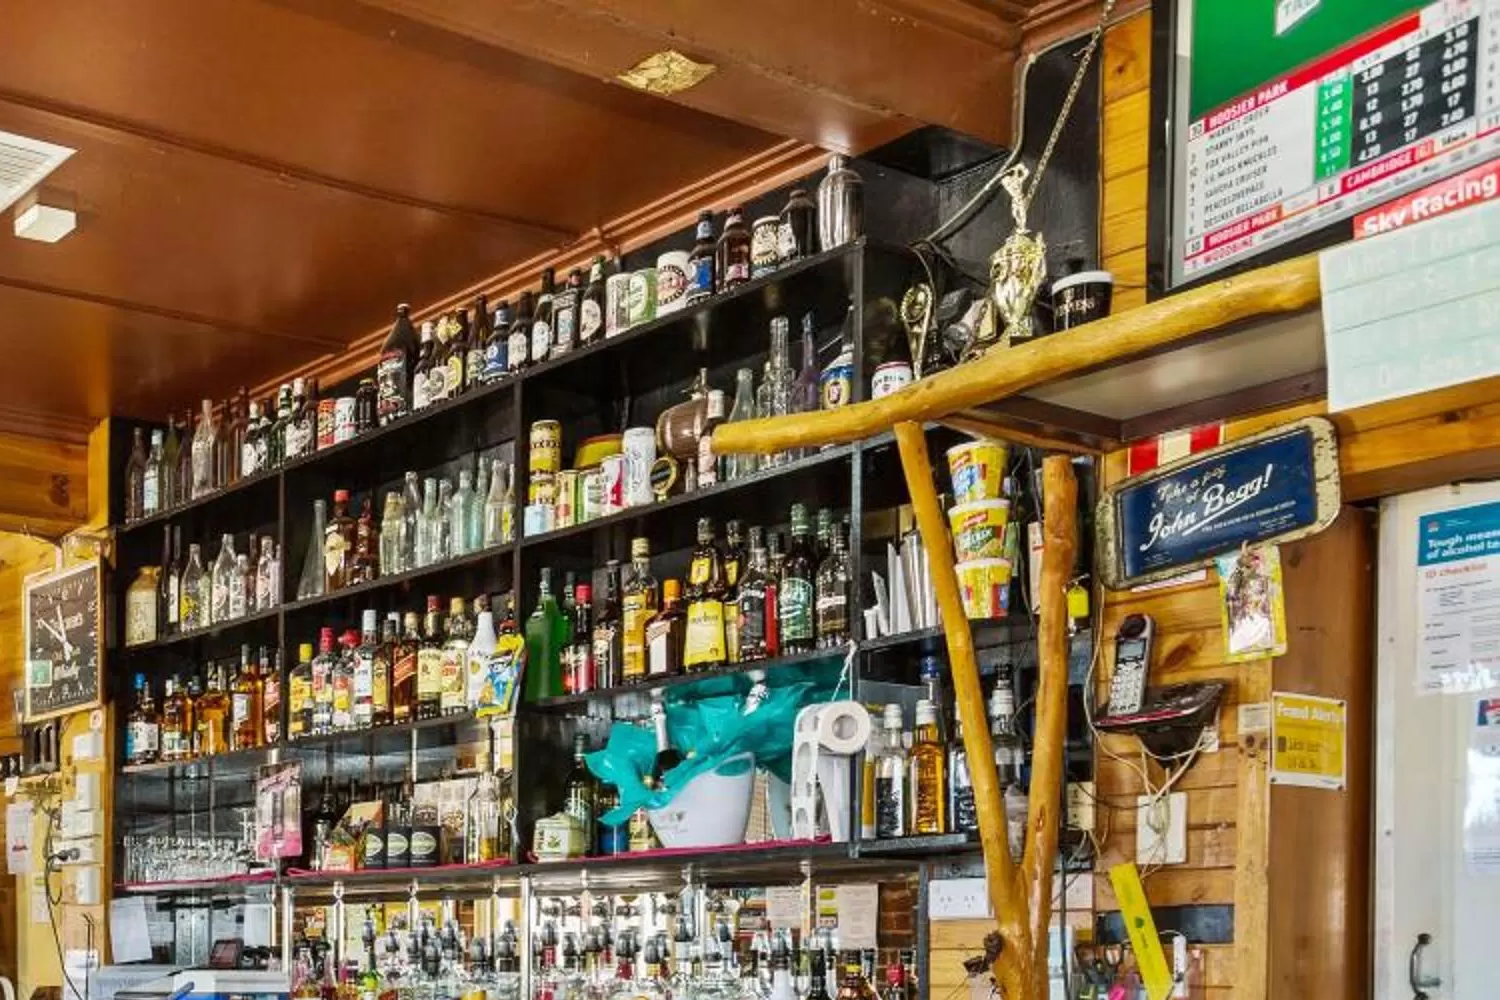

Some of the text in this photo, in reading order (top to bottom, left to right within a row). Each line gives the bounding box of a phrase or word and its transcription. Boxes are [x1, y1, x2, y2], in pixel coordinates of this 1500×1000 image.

[1258, 79, 1290, 104] PARK
[1363, 172, 1498, 236] Sky Racing
[1140, 509, 1197, 552] John
[1203, 463, 1274, 517] Begg!
[1427, 533, 1463, 550] Tough
[1442, 541, 1485, 557] alcohol
